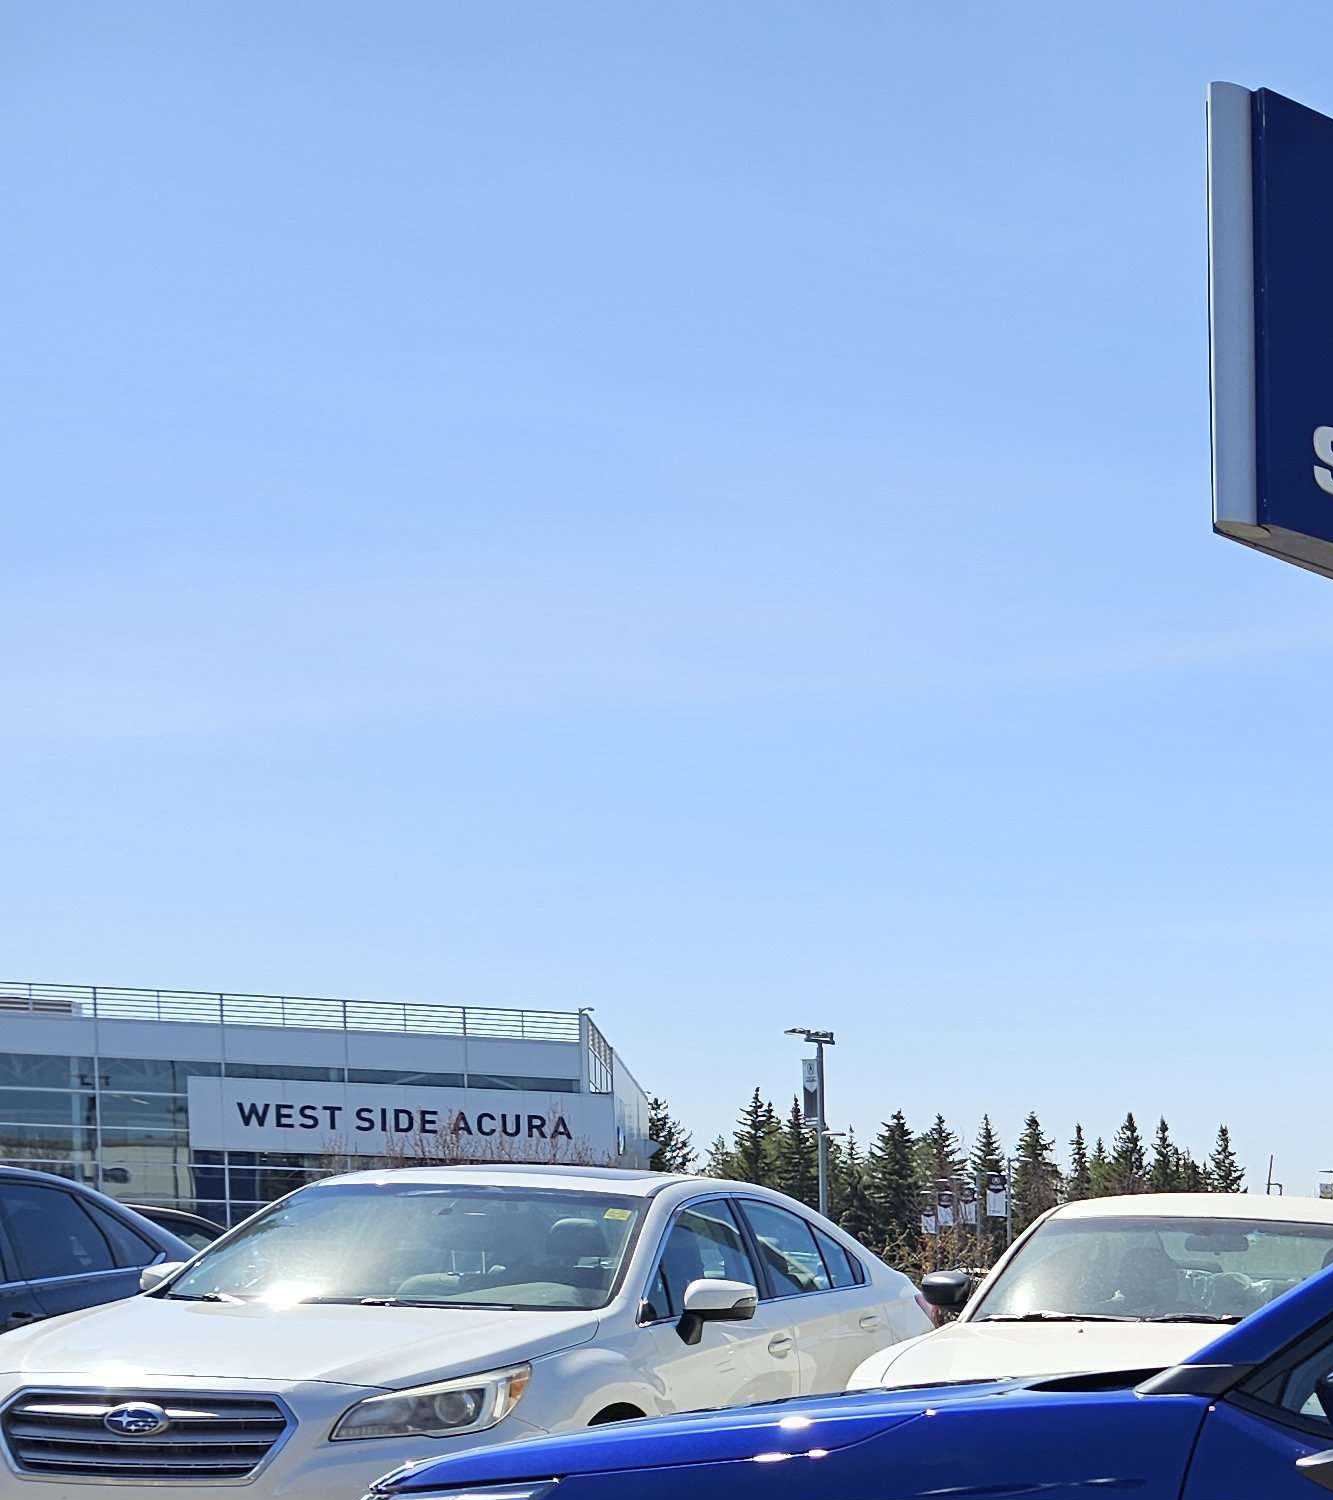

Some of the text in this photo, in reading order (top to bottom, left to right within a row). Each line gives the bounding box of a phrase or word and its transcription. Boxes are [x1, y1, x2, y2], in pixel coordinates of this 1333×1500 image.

[237, 1101, 573, 1141] WEST SIDE ACURA
